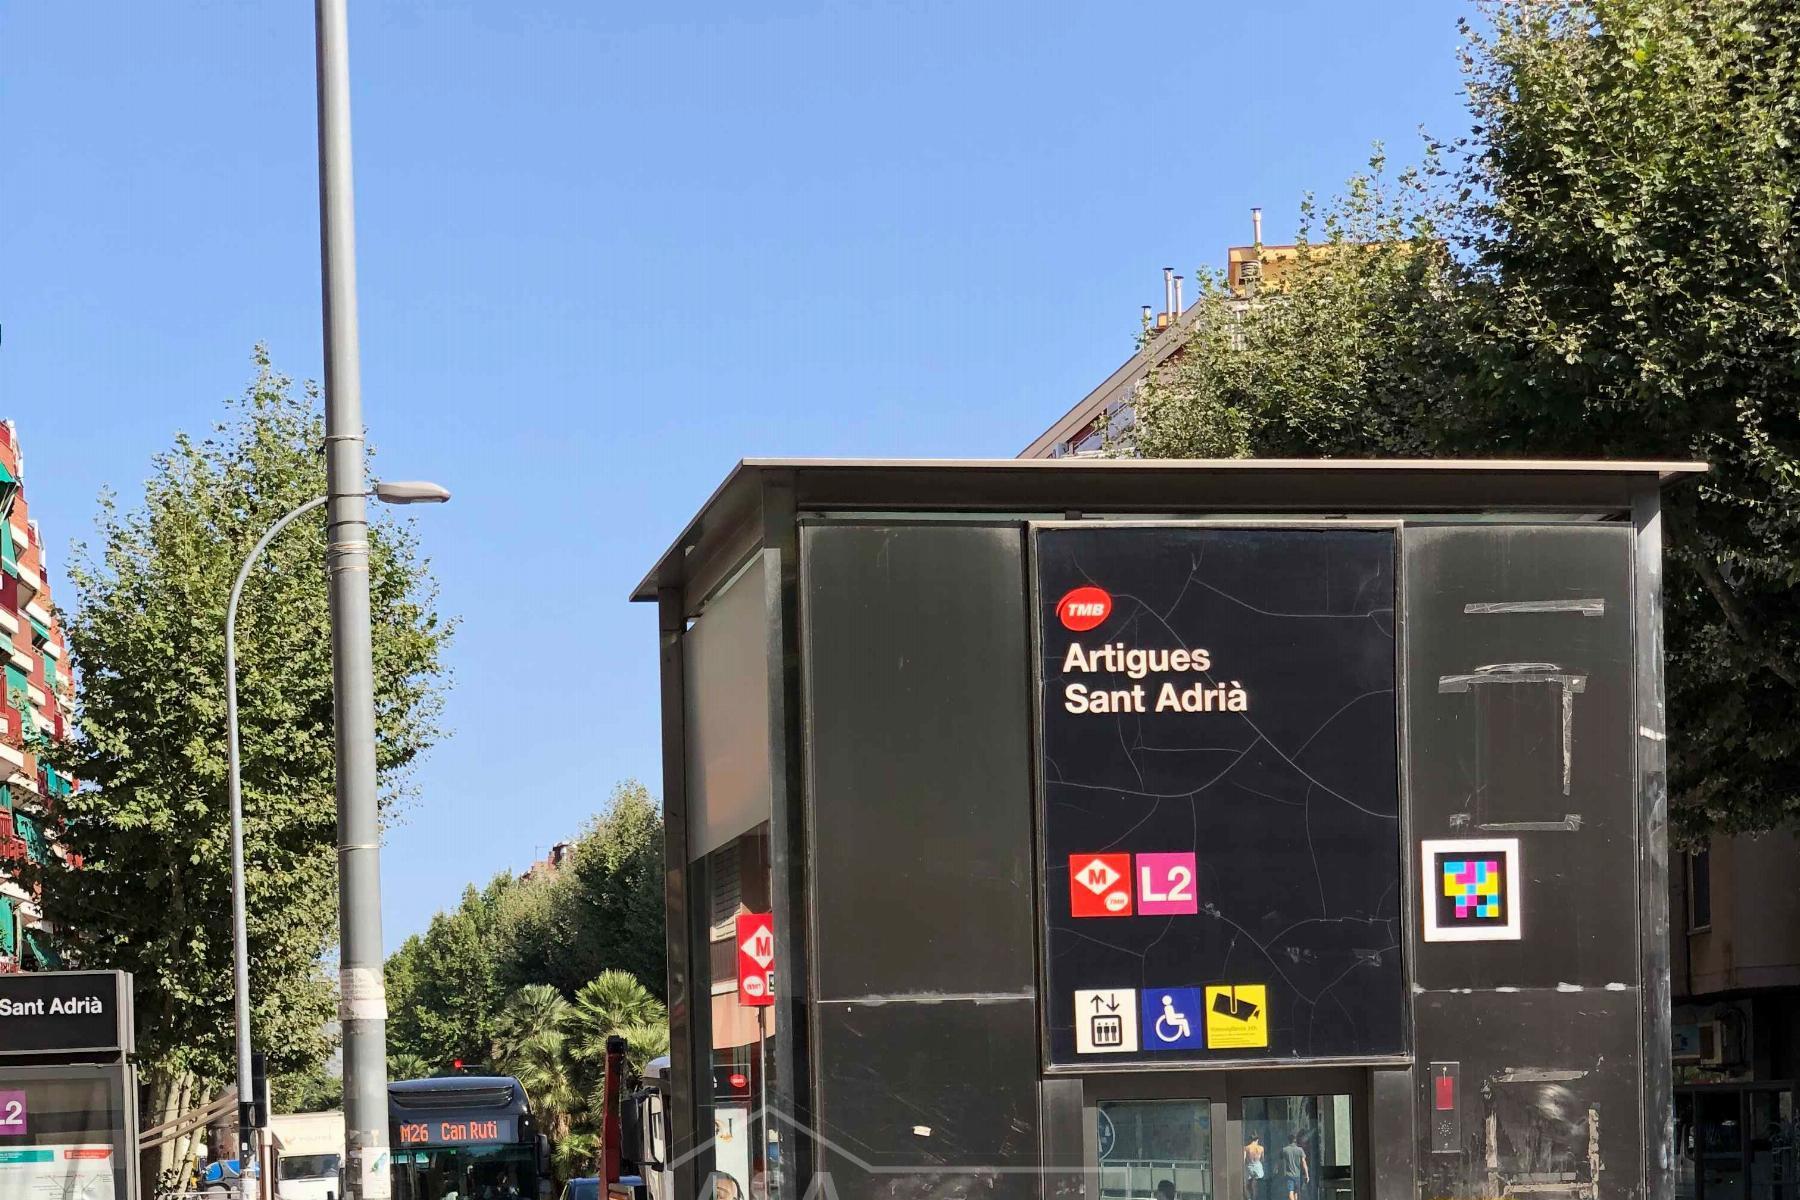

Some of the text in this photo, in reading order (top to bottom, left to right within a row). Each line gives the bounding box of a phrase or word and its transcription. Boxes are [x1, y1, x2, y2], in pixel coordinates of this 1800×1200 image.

[1067, 602, 1105, 617] TMB
[1062, 642, 1211, 679] Artigues
[1064, 681, 1248, 714] Sant Adrià
[1088, 866, 1193, 902] M L2
[0, 996, 103, 1016] Sant Adrià
[0, 1100, 23, 1125] 2
[400, 1120, 498, 1142] M26 Can Ruti
